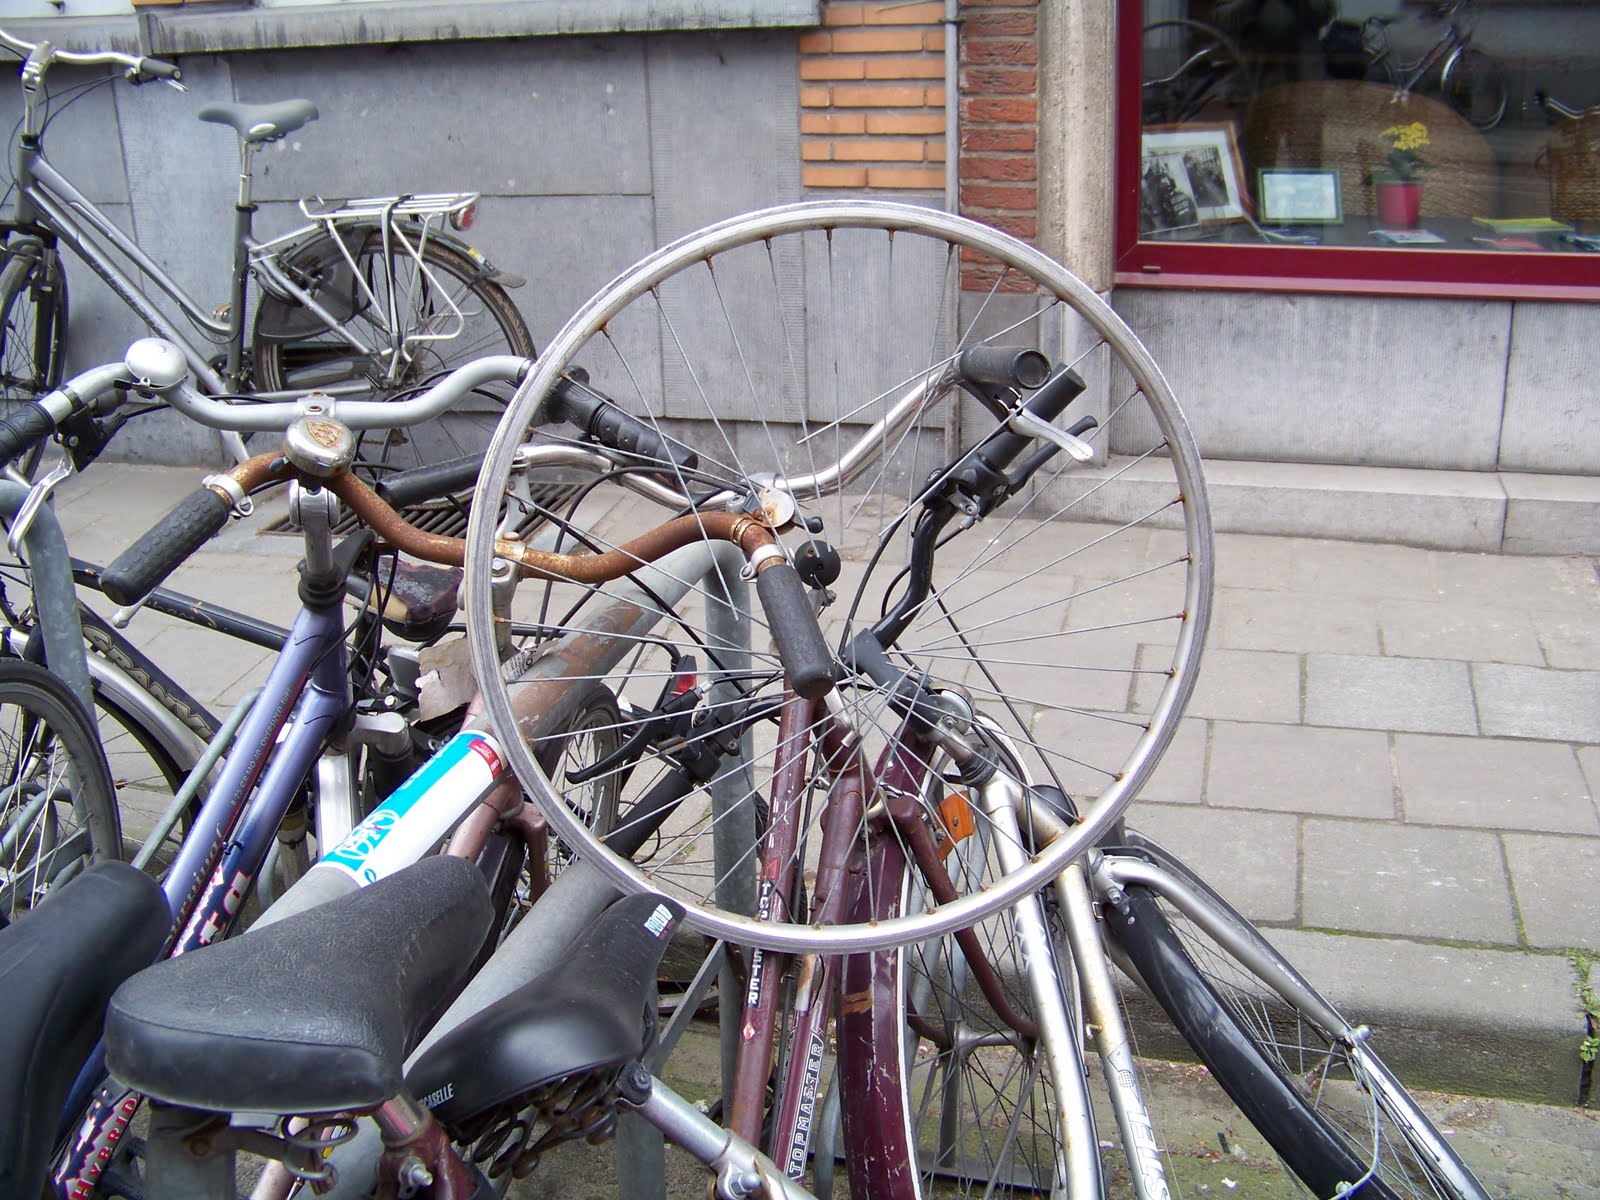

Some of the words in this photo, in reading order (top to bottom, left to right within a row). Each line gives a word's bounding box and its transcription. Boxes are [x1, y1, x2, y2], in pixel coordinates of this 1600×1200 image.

[82, 623, 217, 746] GRANVI
[260, 706, 283, 747] OVERSIZED
[71, 1098, 137, 1200] HYBRID
[789, 1042, 823, 1173] TOPMASTER
